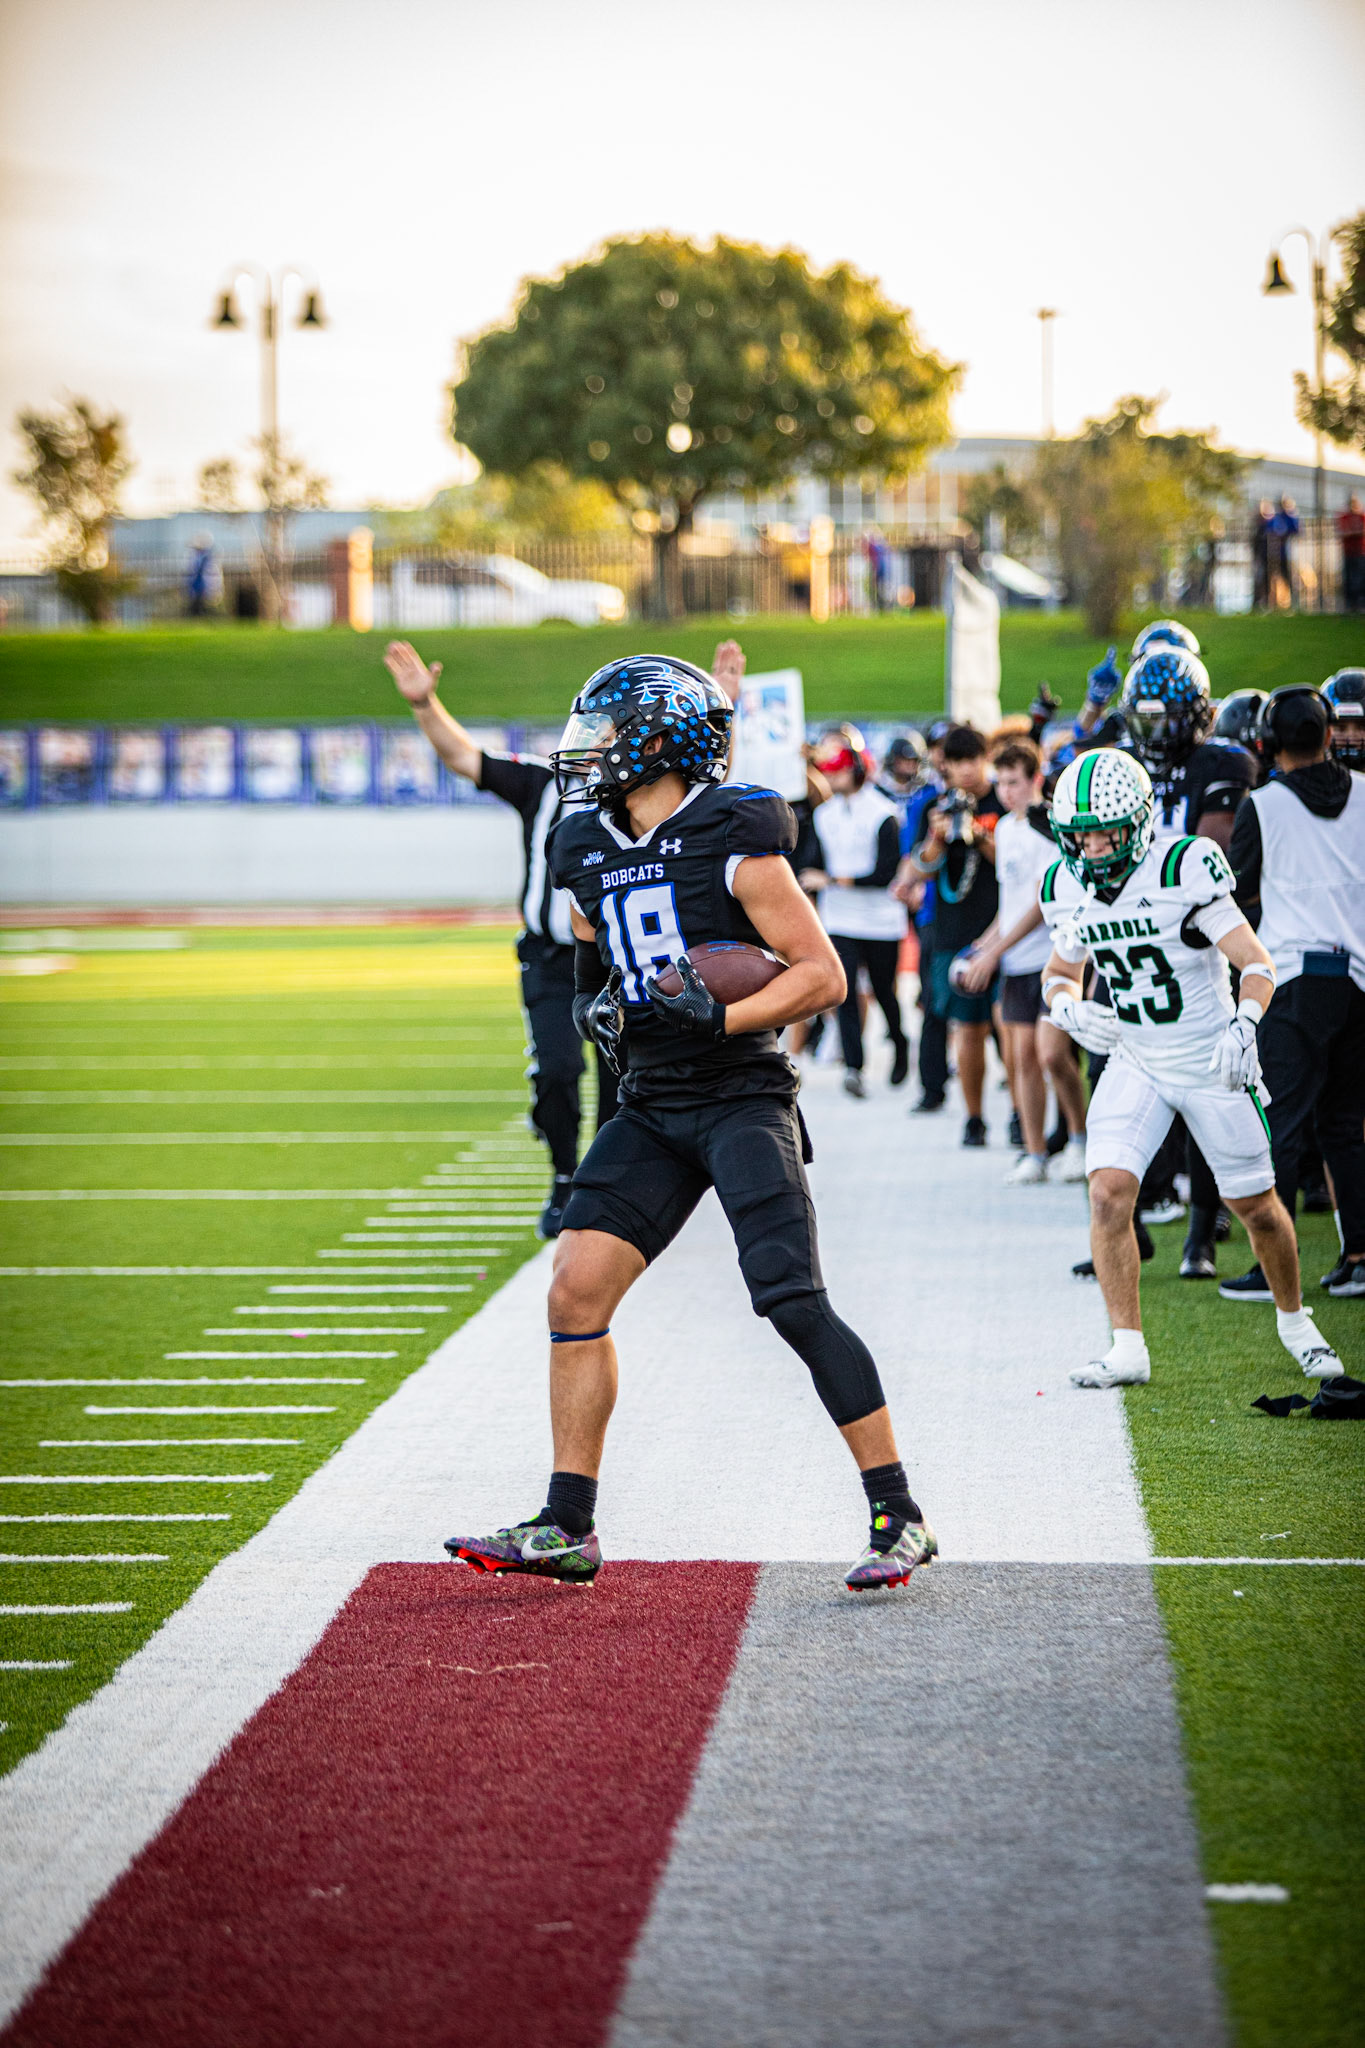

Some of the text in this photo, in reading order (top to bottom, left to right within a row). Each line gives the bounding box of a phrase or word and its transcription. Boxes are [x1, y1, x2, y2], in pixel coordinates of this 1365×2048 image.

[601, 863, 664, 889] BOBCATS
[601, 881, 689, 1003] 18
[1093, 943, 1184, 1025] 23
